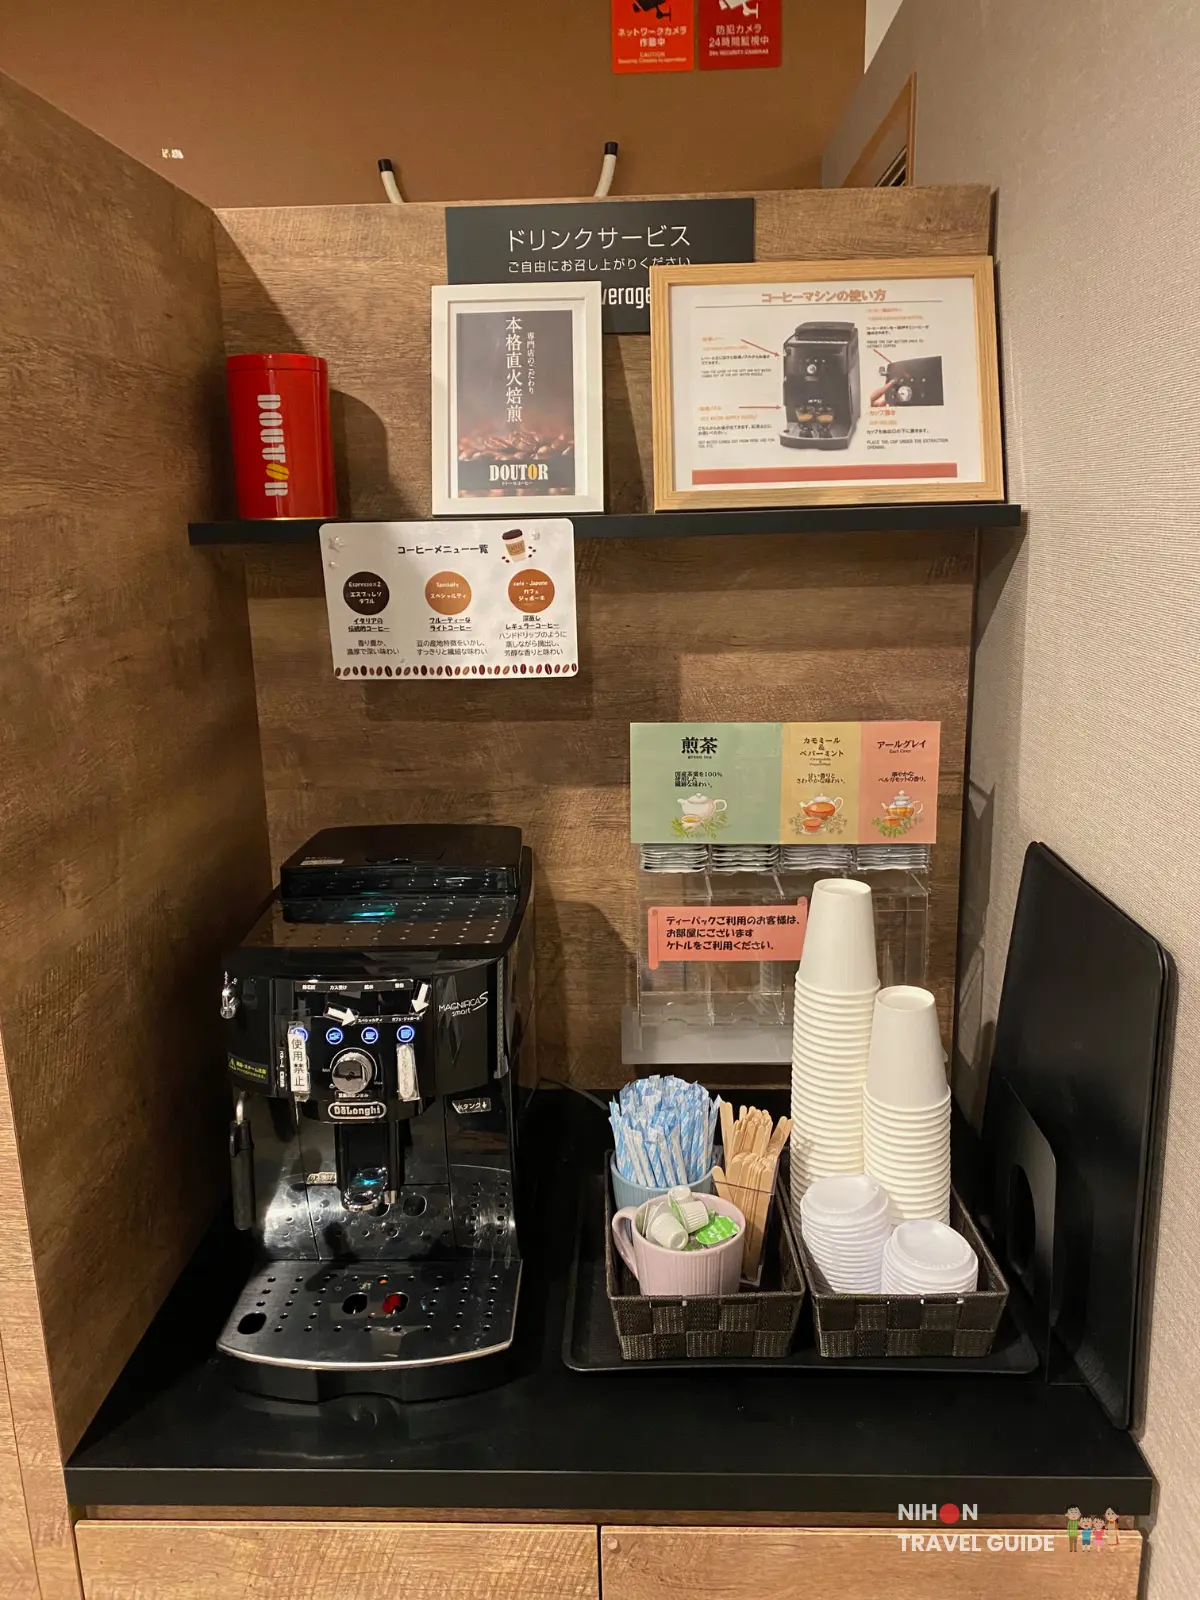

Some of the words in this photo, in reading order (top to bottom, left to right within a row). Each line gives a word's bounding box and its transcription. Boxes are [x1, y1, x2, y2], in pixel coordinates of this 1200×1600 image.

[618, 26, 687, 36] ネットワークカメラ
[716, 24, 761, 35] 防犯カメラ
[709, 35, 769, 48] 24時間監視中
[509, 225, 691, 252] ドリンクサービス
[761, 288, 887, 303] コーヒーマシンの使い方
[527, 332, 536, 395] 専門店のこだわり
[505, 316, 523, 423] 本格直火焙煎
[257, 394, 289, 496] DOUTOR
[489, 463, 549, 481] DOUTOR
[398, 544, 489, 555] コーヒーメニュー一覧
[499, 631, 567, 639] ハンドドリップのように
[417, 648, 488, 656] すっきりと繊細な味わい
[504, 649, 564, 657] 芳醇な香りと味わい
[681, 736, 718, 754] 煎茶
[877, 739, 926, 750] アールグレイ
[666, 928, 754, 938] お部屋にございます
[666, 941, 774, 951] ケトルをご利用ください。
[452, 1007, 470, 1017] smart
[291, 1038, 305, 1087] 使用禁止
